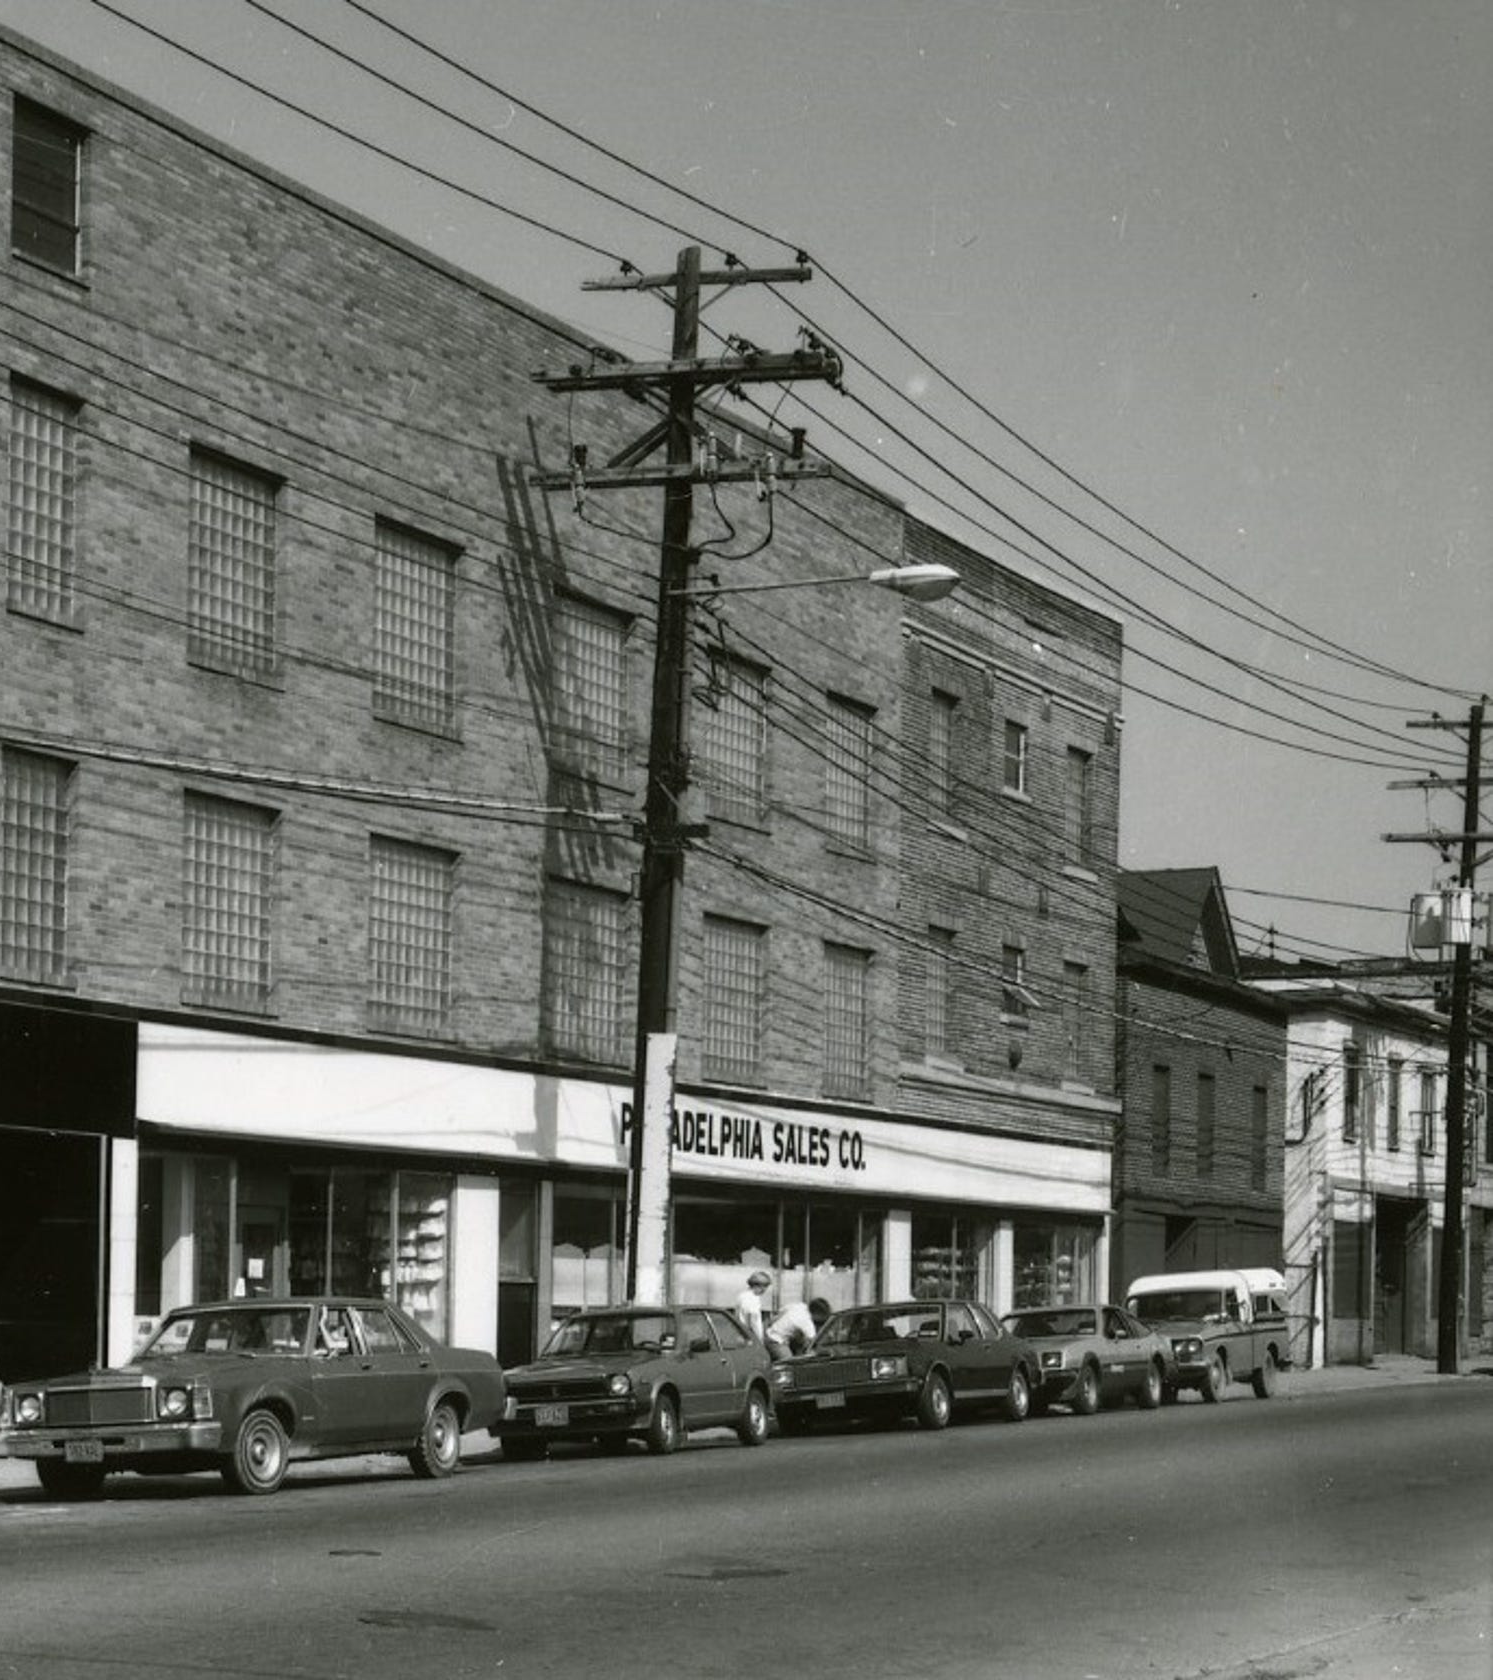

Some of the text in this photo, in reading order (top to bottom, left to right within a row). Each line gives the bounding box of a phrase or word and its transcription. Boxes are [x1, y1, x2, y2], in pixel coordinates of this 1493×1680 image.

[620, 1102, 866, 1170] PADELPHIA SALES CO.
